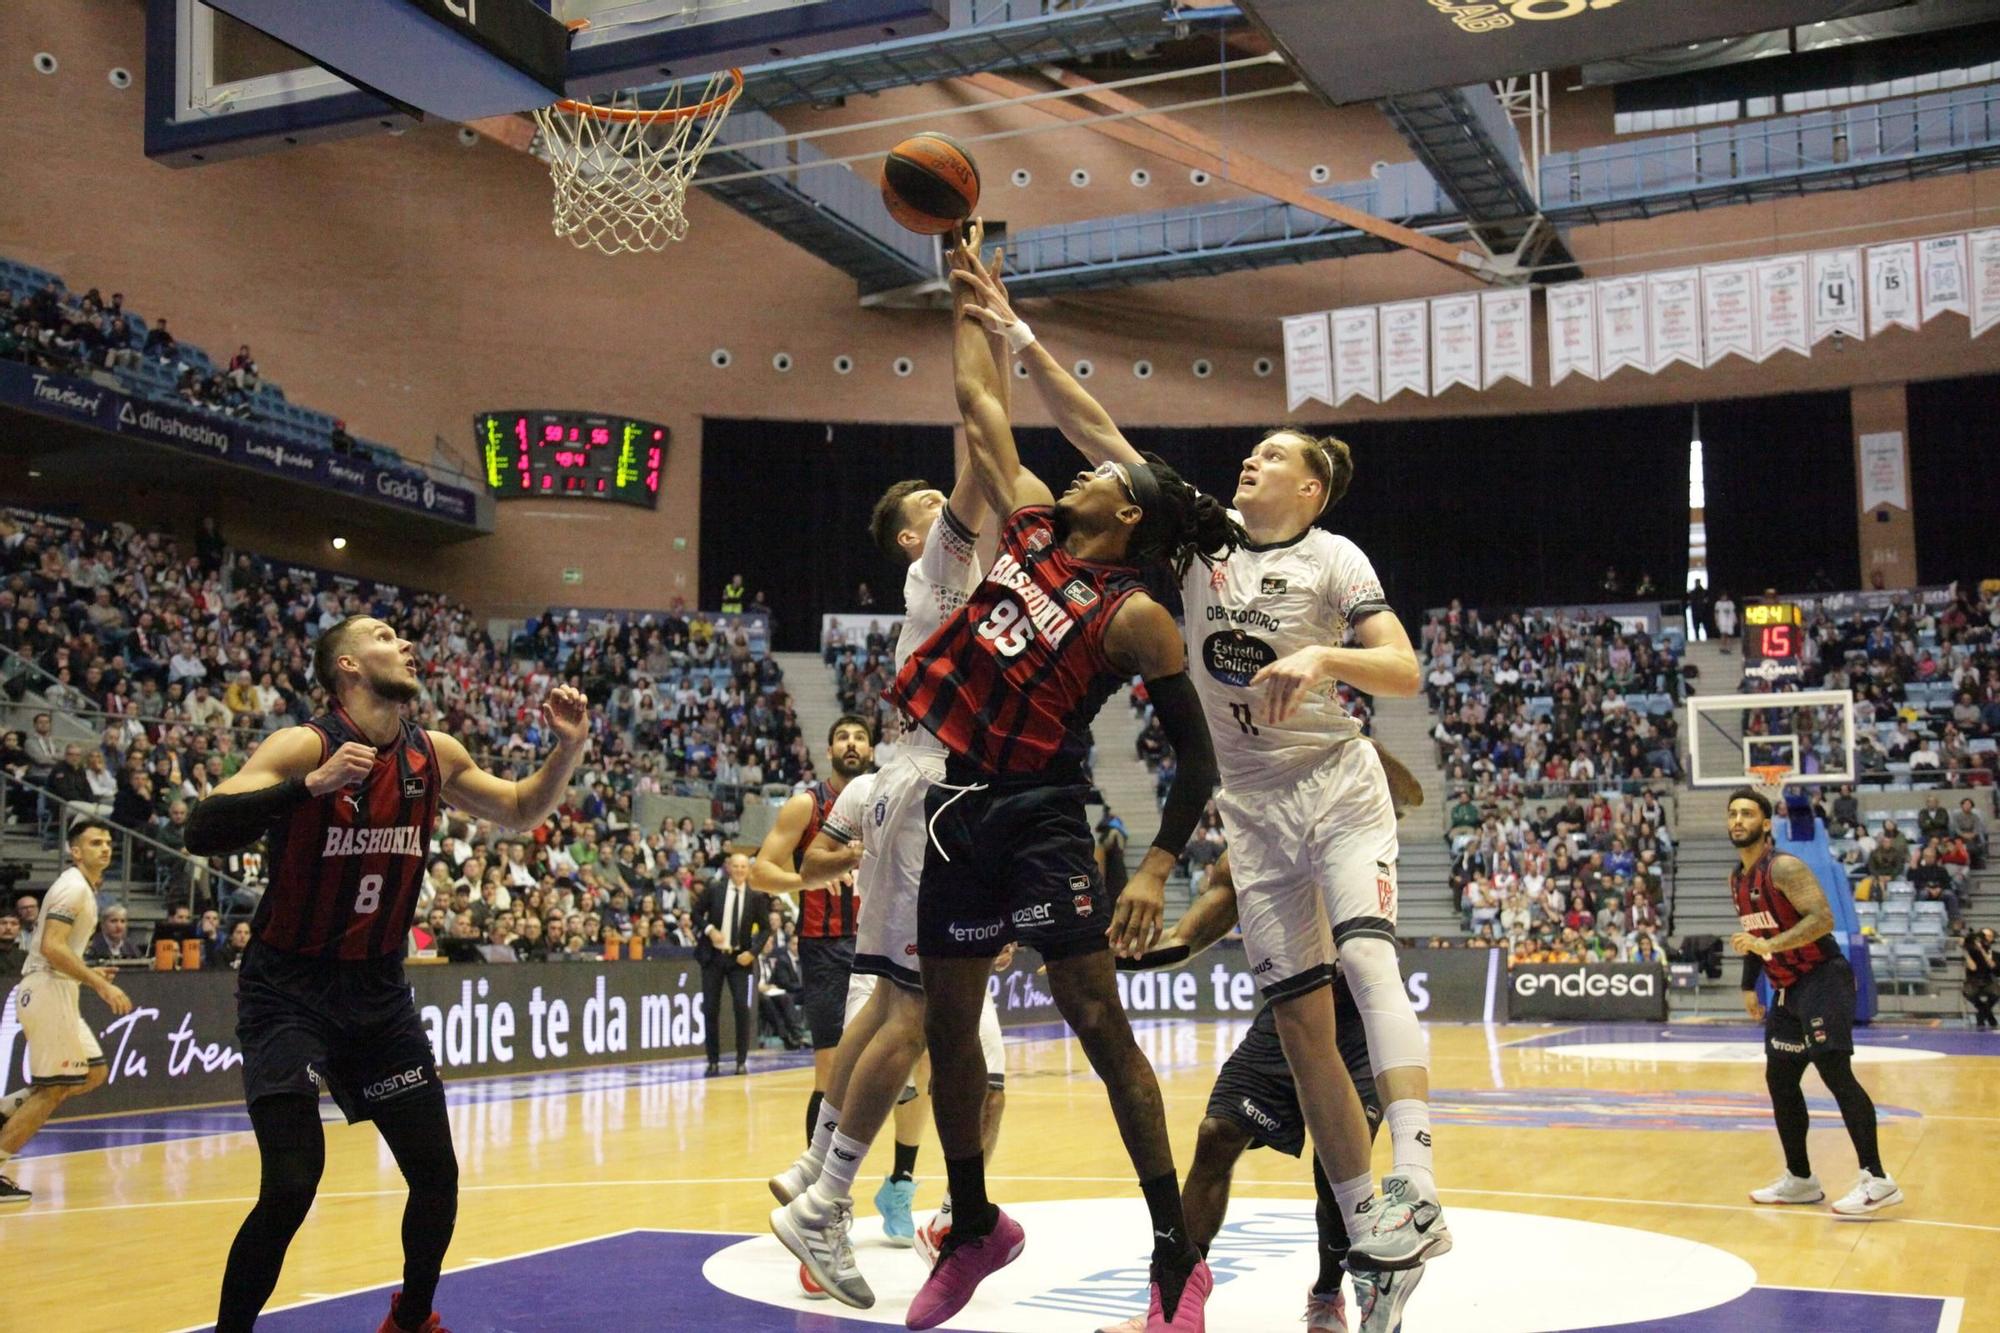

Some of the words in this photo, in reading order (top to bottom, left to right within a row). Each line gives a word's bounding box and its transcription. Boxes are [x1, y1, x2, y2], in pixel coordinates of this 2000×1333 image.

[1828, 283, 1845, 306] 4
[1885, 275, 1900, 290] 15
[139, 410, 229, 454] dinahosting
[376, 471, 418, 502] Grada
[987, 553, 1075, 651] BASKONIA
[978, 598, 1035, 657] 95
[1212, 637, 1264, 661] Estrella
[1213, 654, 1260, 674] Galicia
[1229, 702, 1260, 736] 11
[322, 825, 423, 858] BASKONIA
[354, 874, 384, 914] 8
[1210, 963, 1255, 1011] te
[1515, 967, 1654, 997] endesa
[416, 976, 515, 1067] adie
[529, 986, 570, 1060] te
[582, 975, 627, 1055] da
[641, 972, 706, 1049] más
[100, 1006, 160, 1085] Tu
